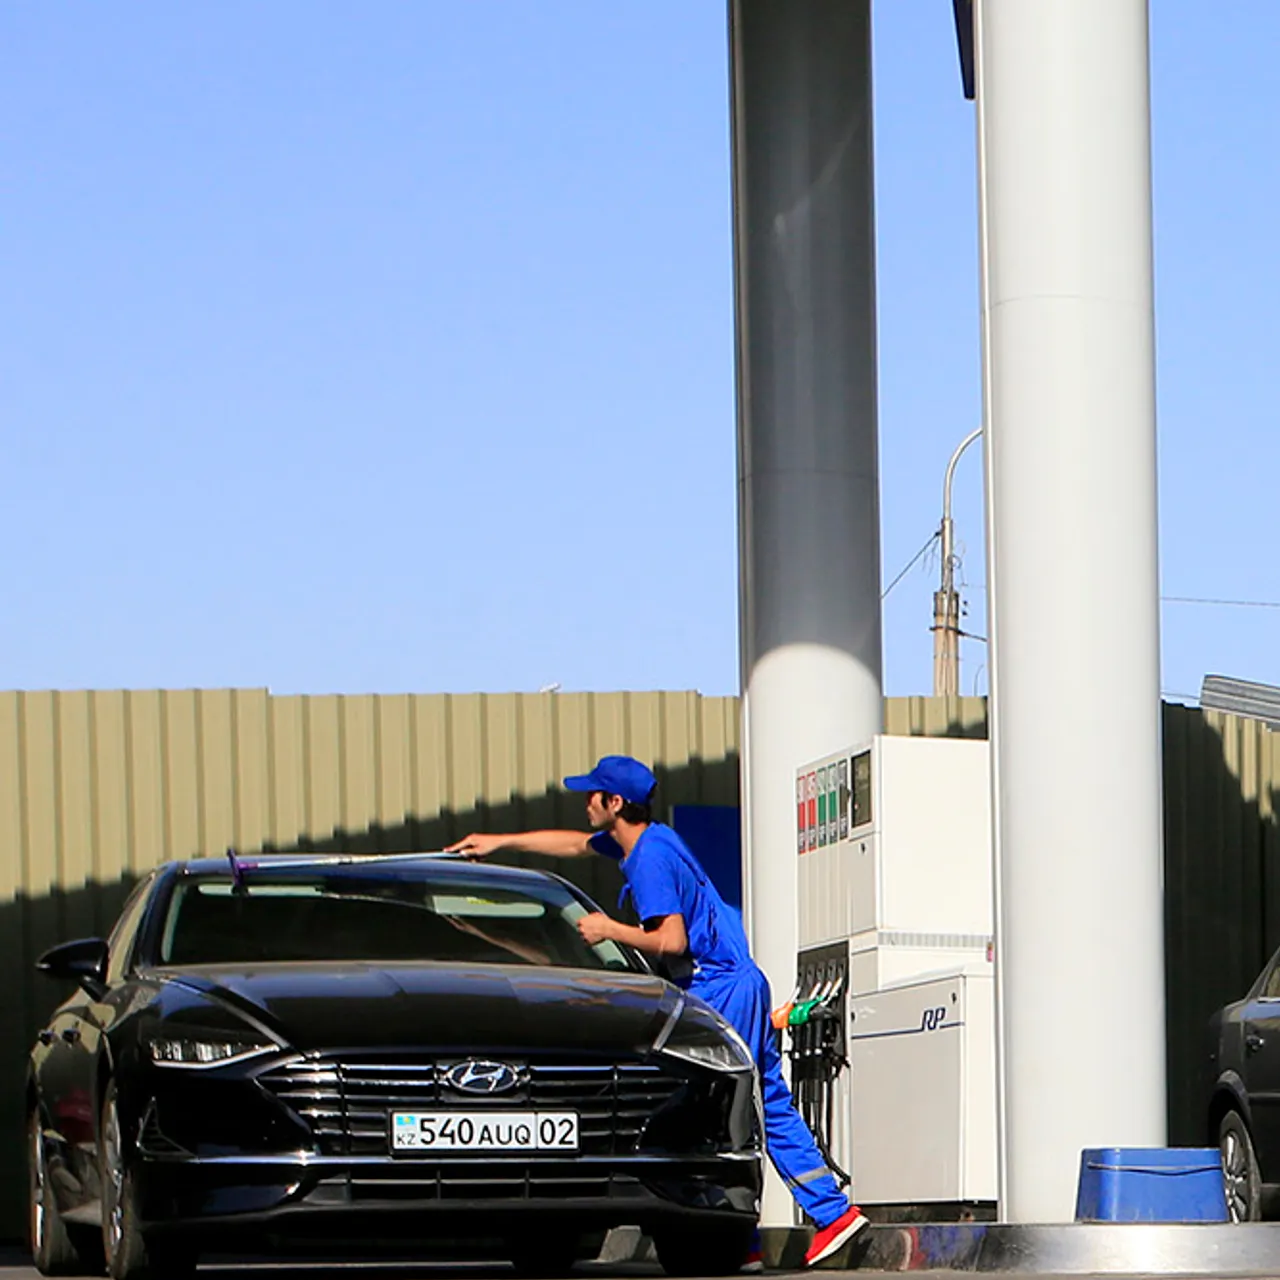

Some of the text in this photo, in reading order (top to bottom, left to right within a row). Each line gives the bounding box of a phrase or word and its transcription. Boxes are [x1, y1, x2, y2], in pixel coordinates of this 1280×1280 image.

[922, 1007, 946, 1031] RP
[396, 1133, 416, 1145] KZ
[540, 1118, 575, 1145] 02
